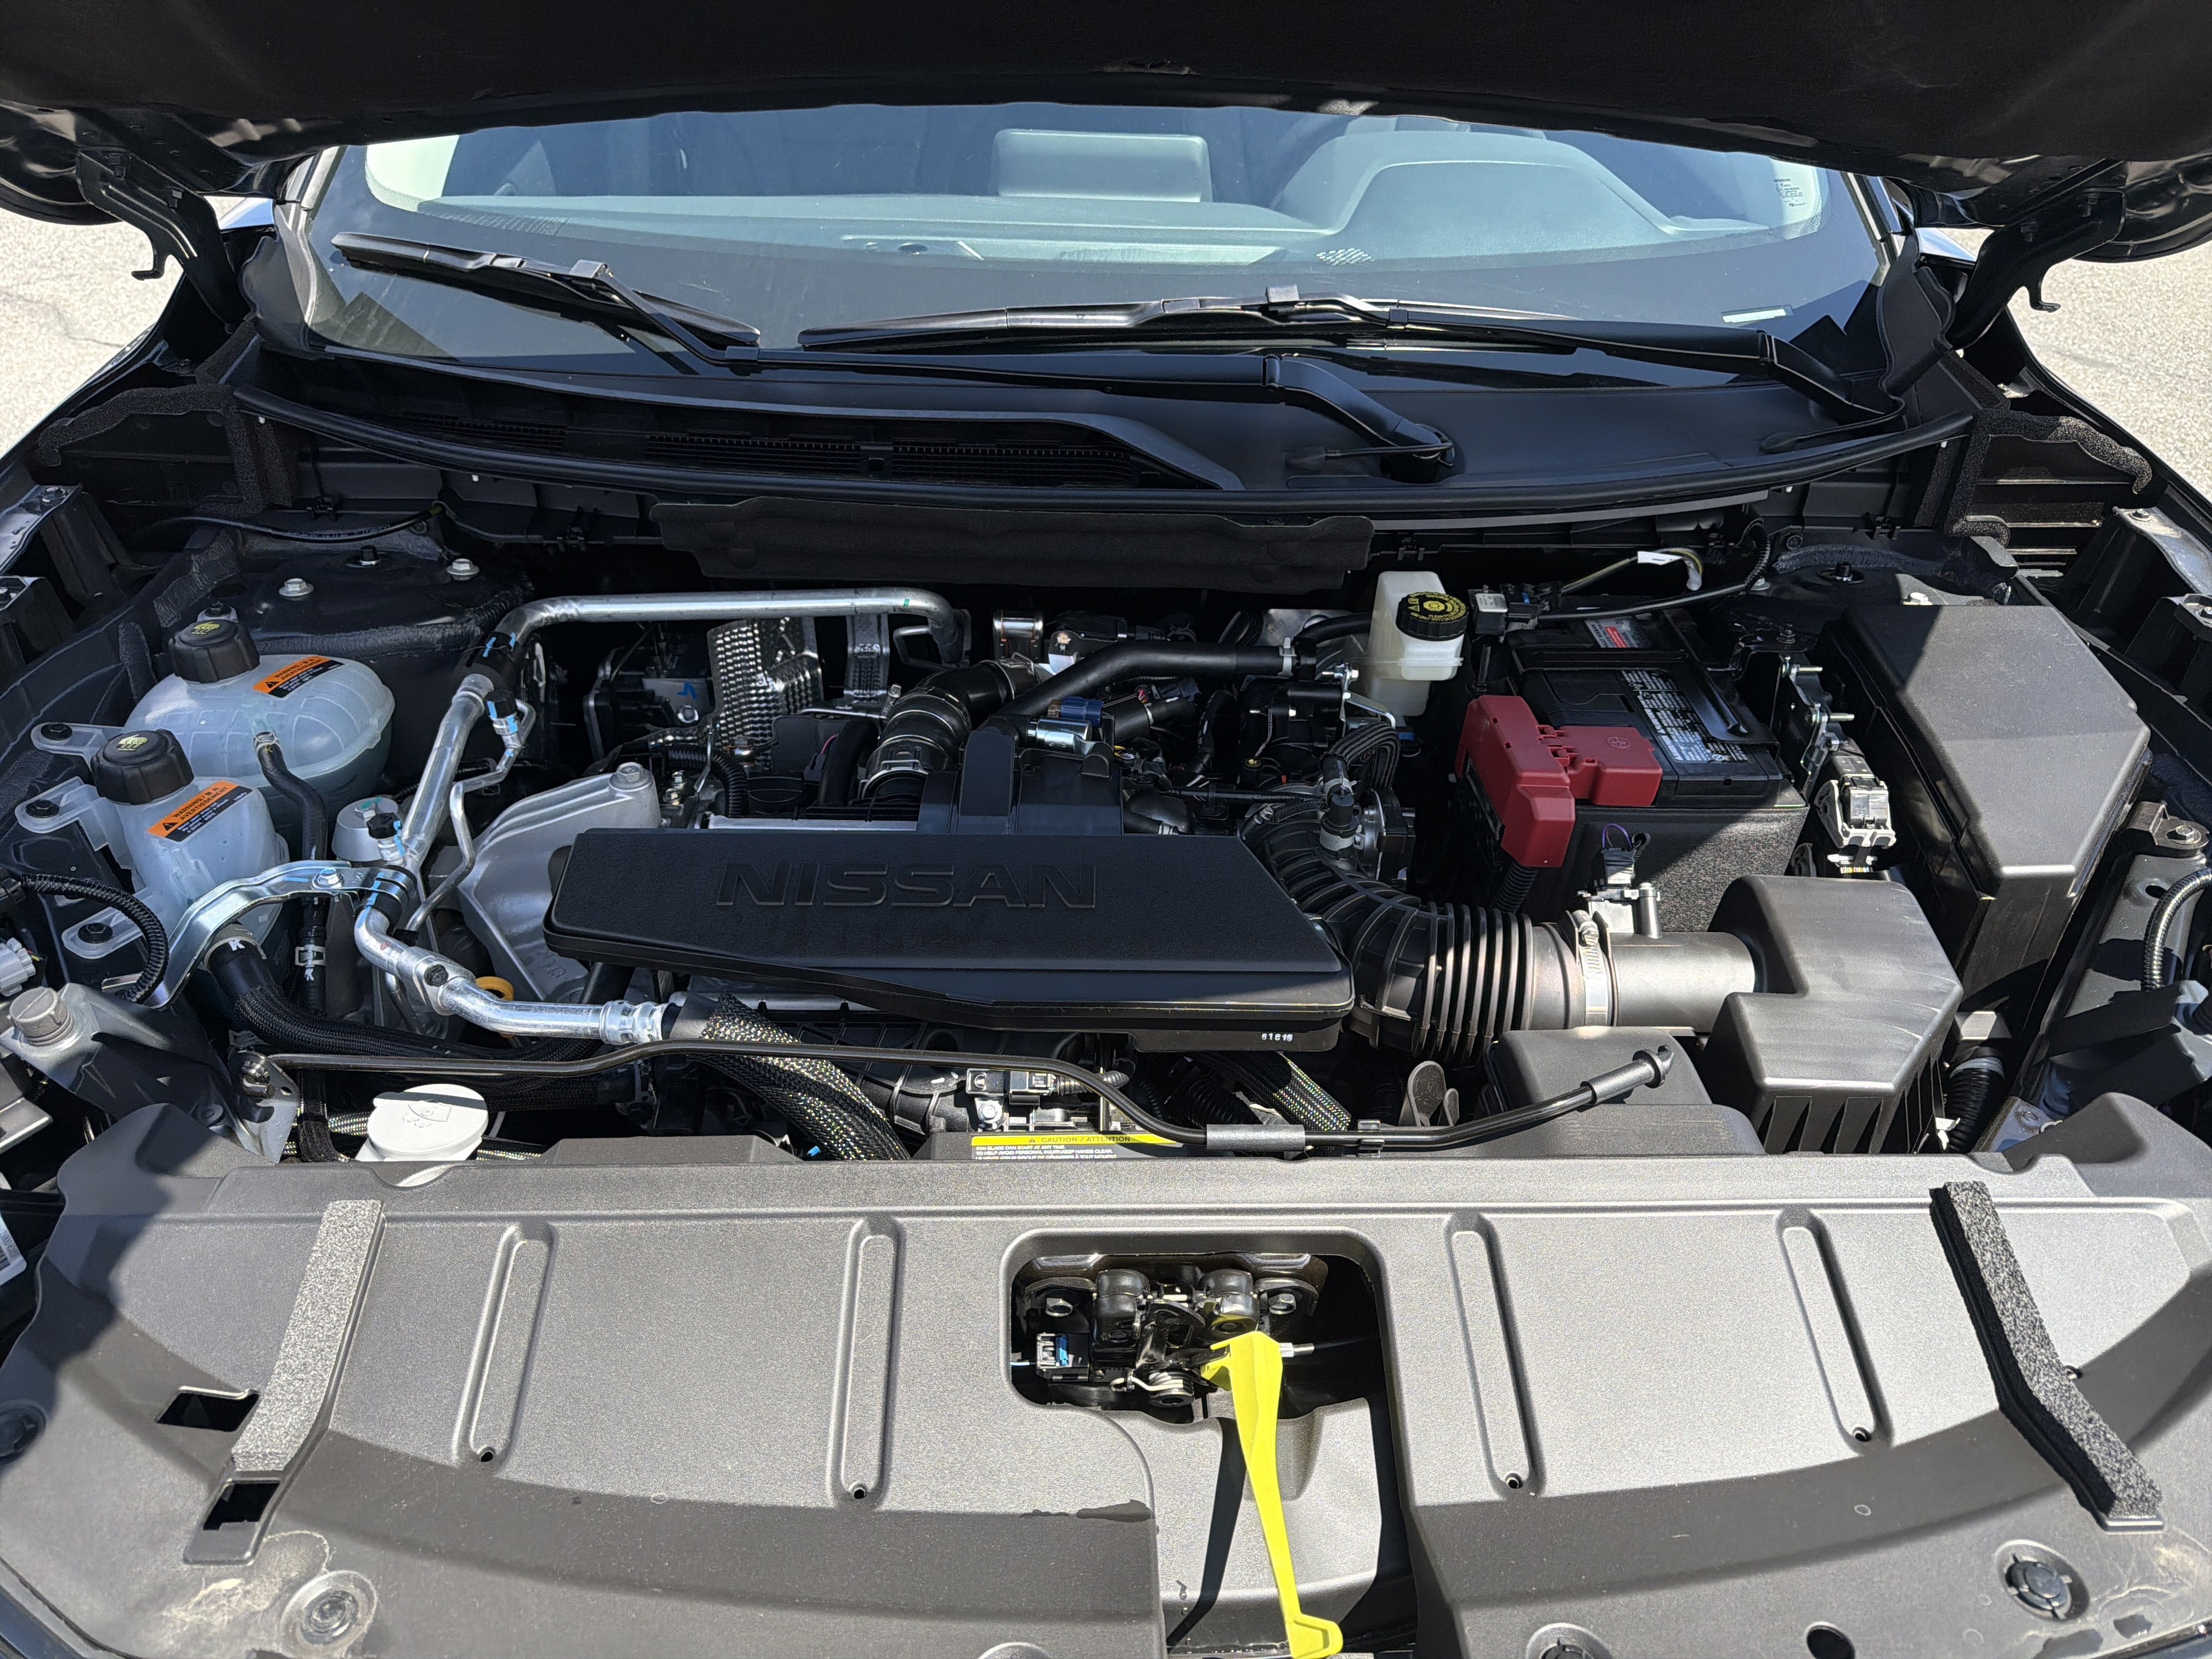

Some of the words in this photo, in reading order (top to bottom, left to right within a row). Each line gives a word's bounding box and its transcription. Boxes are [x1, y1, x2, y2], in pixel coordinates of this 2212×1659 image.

[180, 787, 228, 821] AVERTISSEMENT
[716, 862, 1096, 909] NISSAN
[229, 939, 246, 951] K
[304, 968, 314, 981] K
